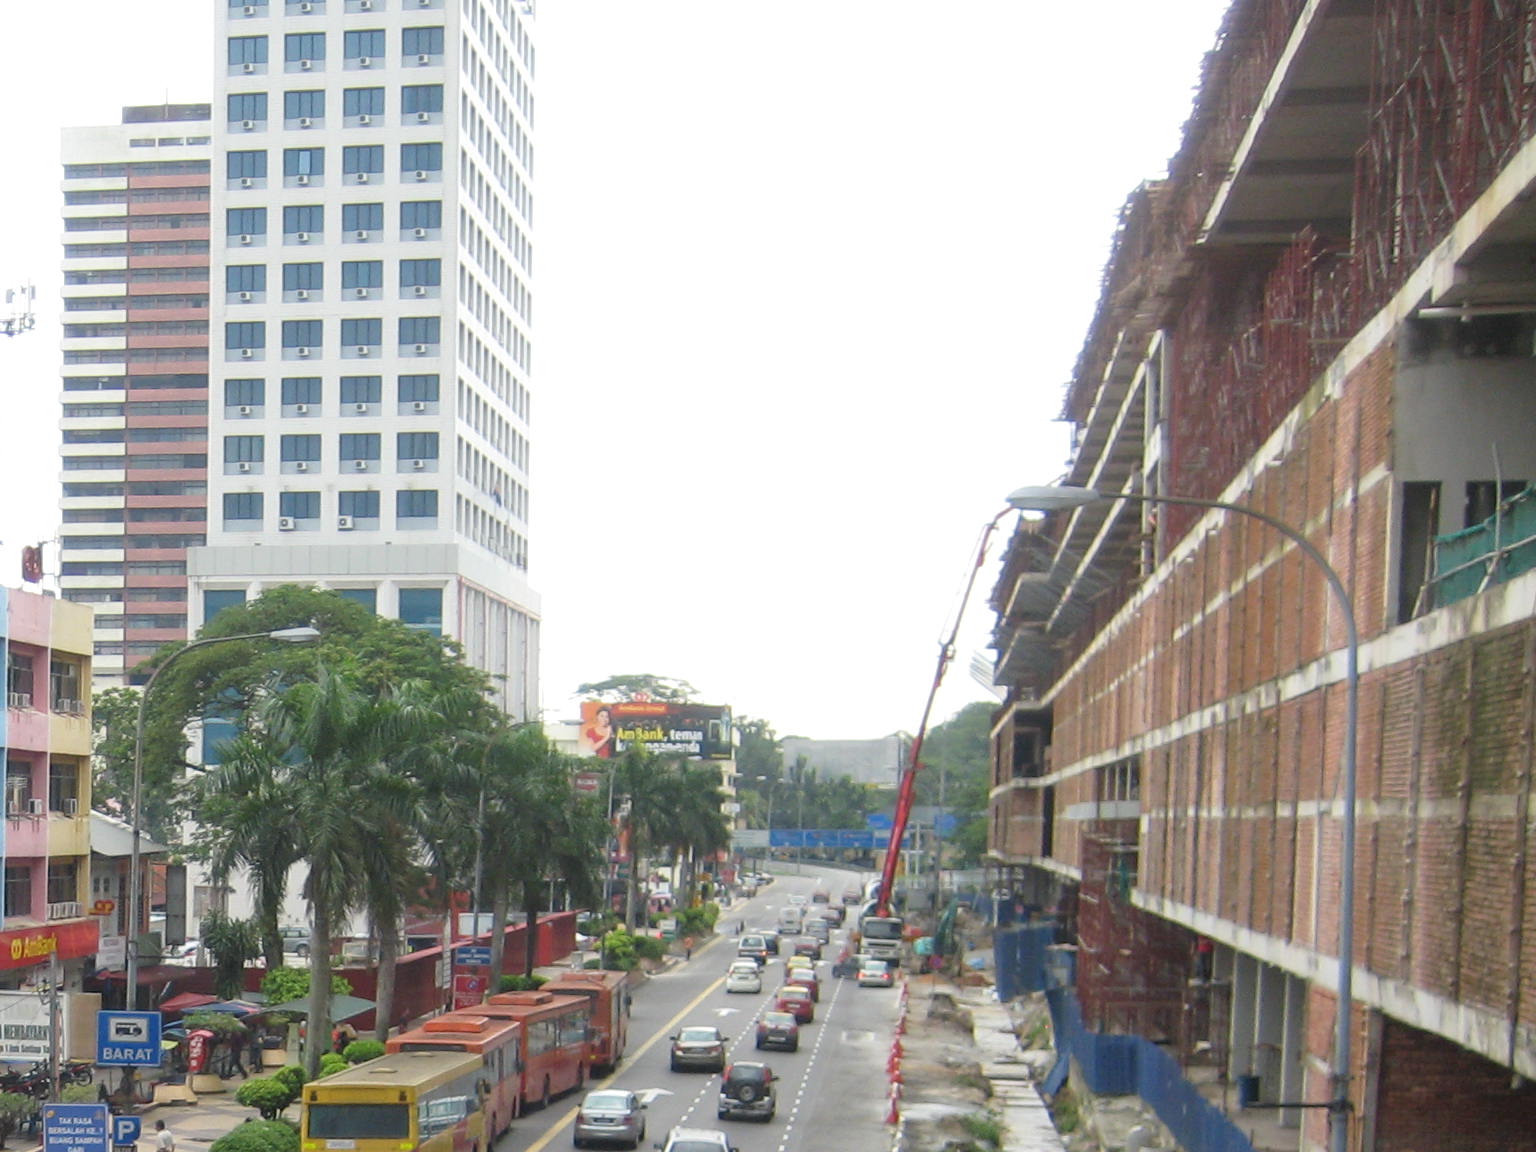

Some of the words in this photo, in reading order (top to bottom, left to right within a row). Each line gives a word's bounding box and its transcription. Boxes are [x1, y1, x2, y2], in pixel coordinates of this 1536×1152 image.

[617, 727, 667, 741] AmBank,
[670, 729, 703, 741] teman
[24, 933, 57, 957] AmBank
[103, 1048, 153, 1060] BARAT
[59, 1117, 72, 1125] TAK
[118, 1121, 135, 1141] P
[49, 1137, 74, 1145] BUANG
[75, 1137, 103, 1145] SAMPAH
